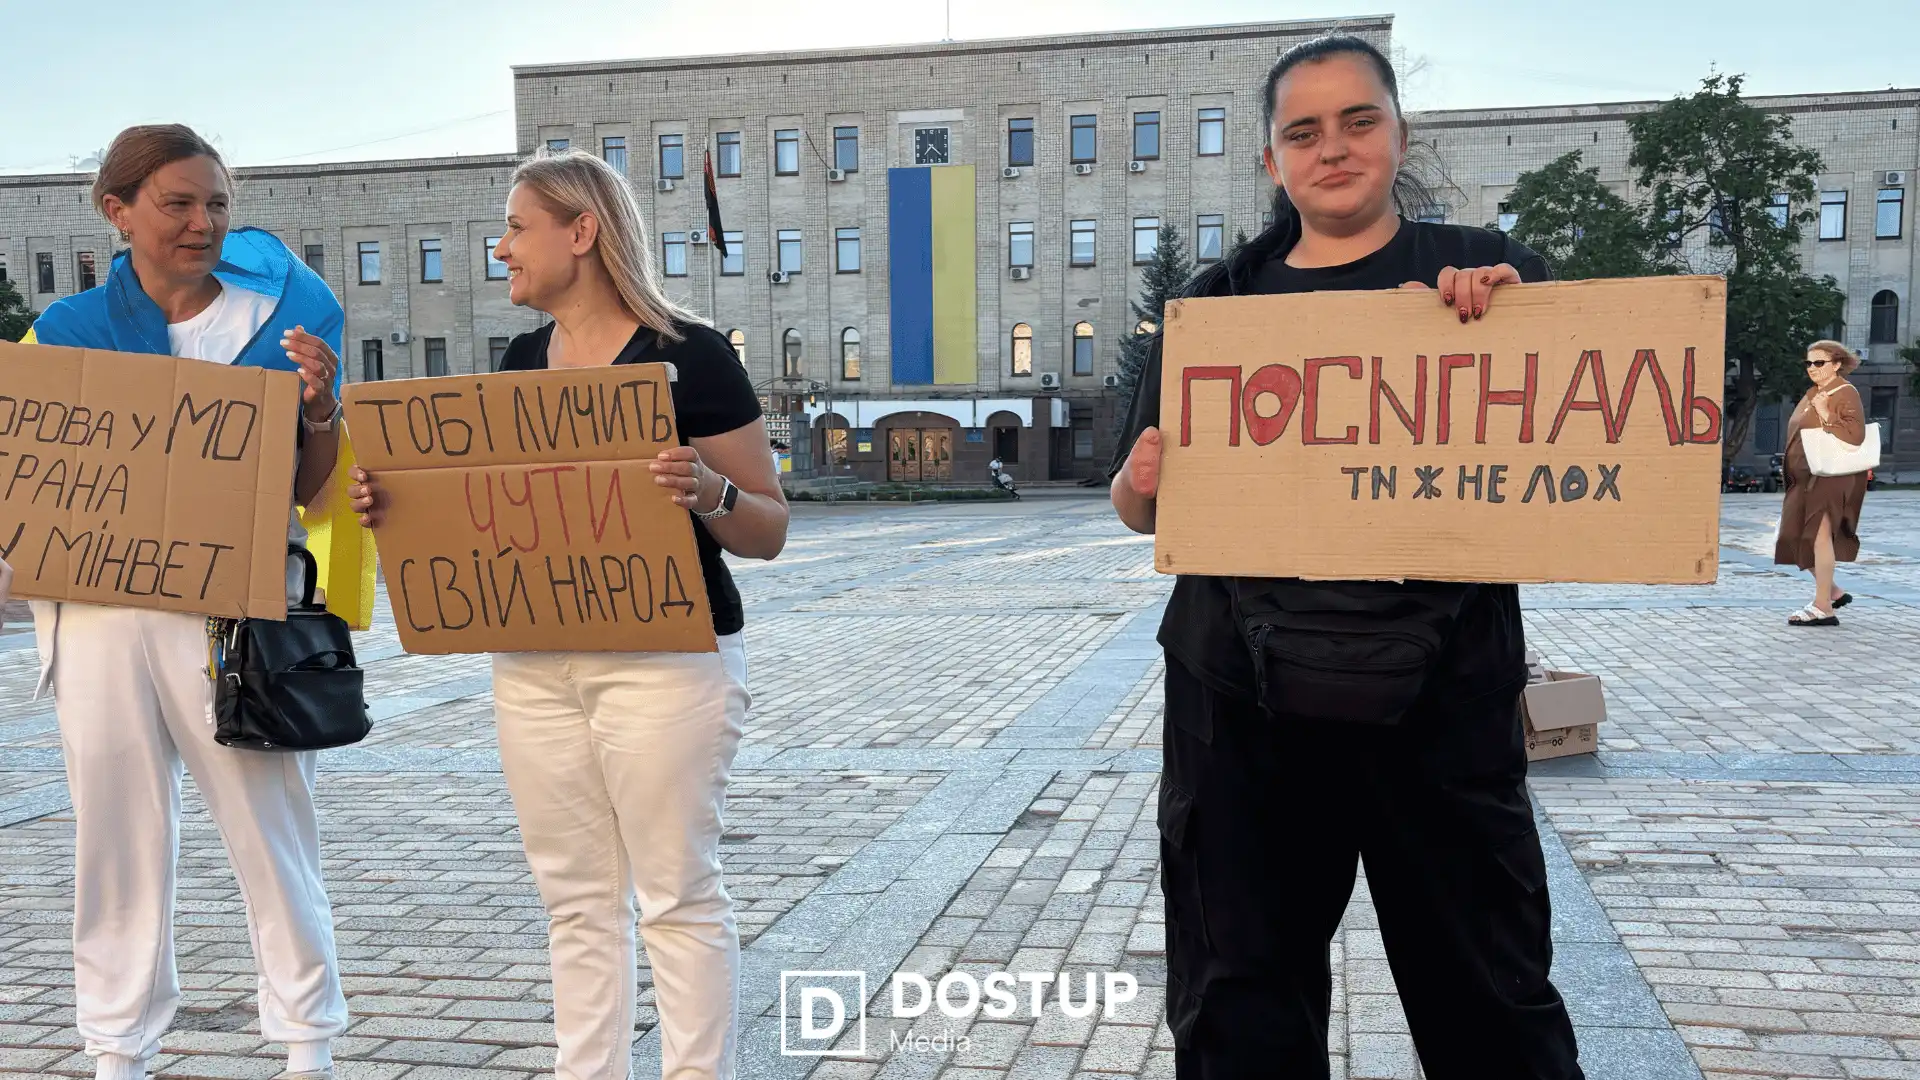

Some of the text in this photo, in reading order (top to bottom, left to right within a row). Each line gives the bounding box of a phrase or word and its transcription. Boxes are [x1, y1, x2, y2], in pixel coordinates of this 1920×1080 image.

[164, 392, 257, 461] МО
[354, 380, 673, 456] ТОБІ ЛИЧИТЬ
[0, 452, 130, 515] РАНА
[464, 465, 632, 554] ЧУТИ
[1413, 465, 1444, 499] Ж
[1457, 464, 1508, 502] НЕ
[1521, 463, 1622, 503] ЛОХ
[35, 519, 235, 600] МІНВЕТ
[400, 547, 695, 633] СВІЙ НАРОД
